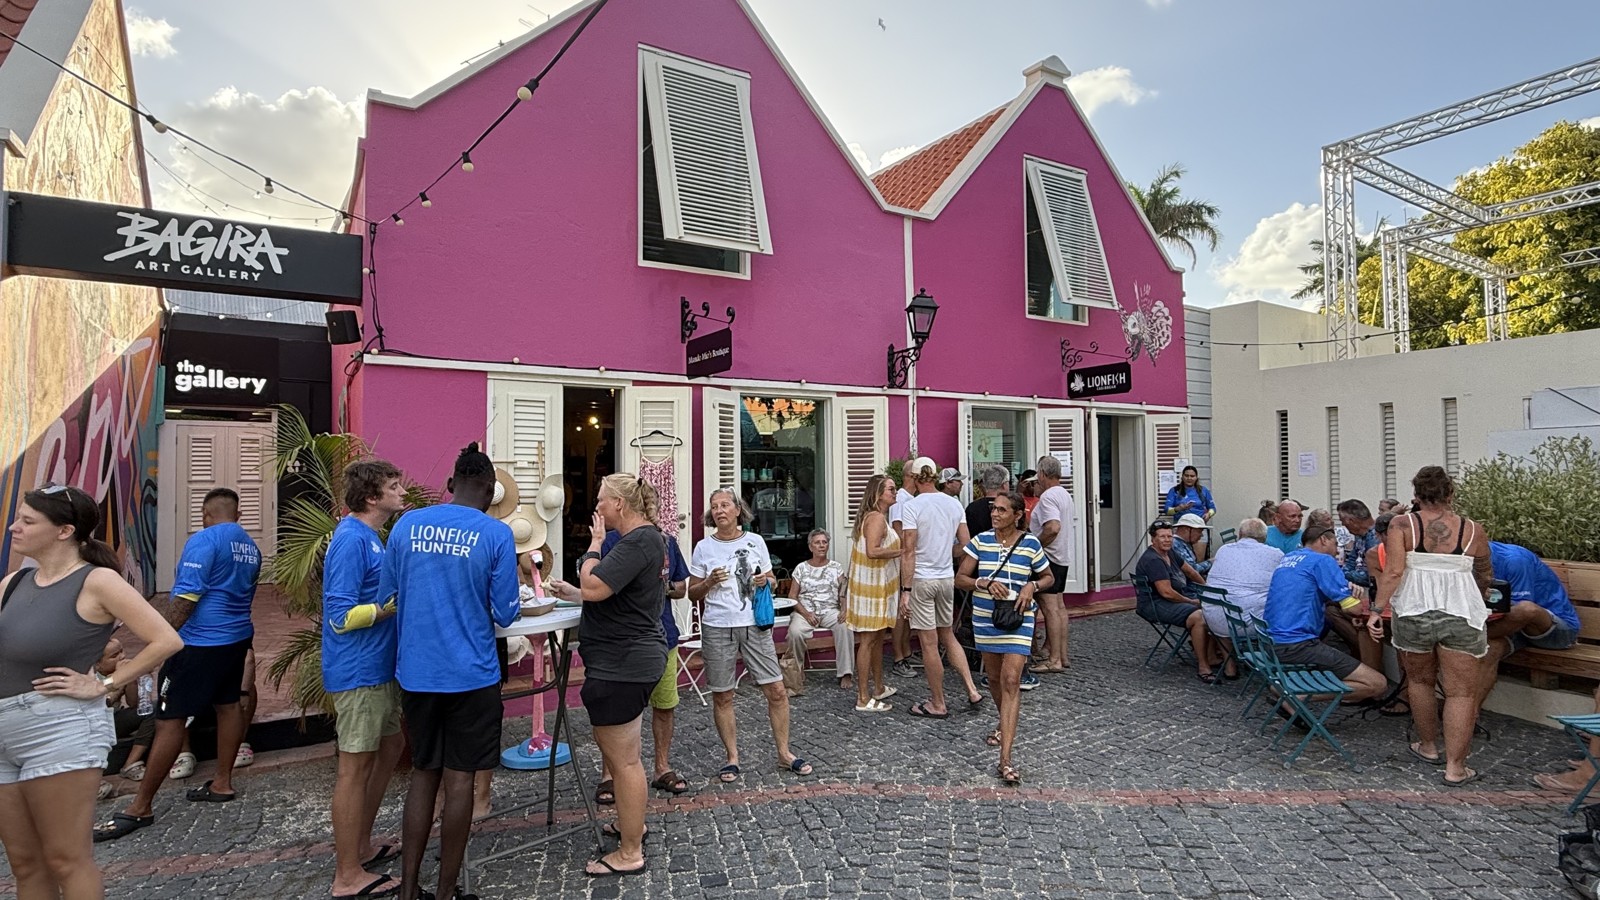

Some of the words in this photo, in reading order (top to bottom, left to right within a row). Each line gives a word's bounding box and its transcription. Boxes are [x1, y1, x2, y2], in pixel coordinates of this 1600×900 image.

[103, 211, 290, 275] BAGIRA
[134, 260, 171, 273] ART
[180, 264, 261, 282] GALLERY
[176, 359, 206, 374] the
[174, 369, 267, 394] gallery
[1087, 372, 1126, 388] LIONFISH
[410, 524, 481, 547] LIONFISH
[233, 553, 259, 565] HUNTER
[411, 540, 471, 558] HUNTER
